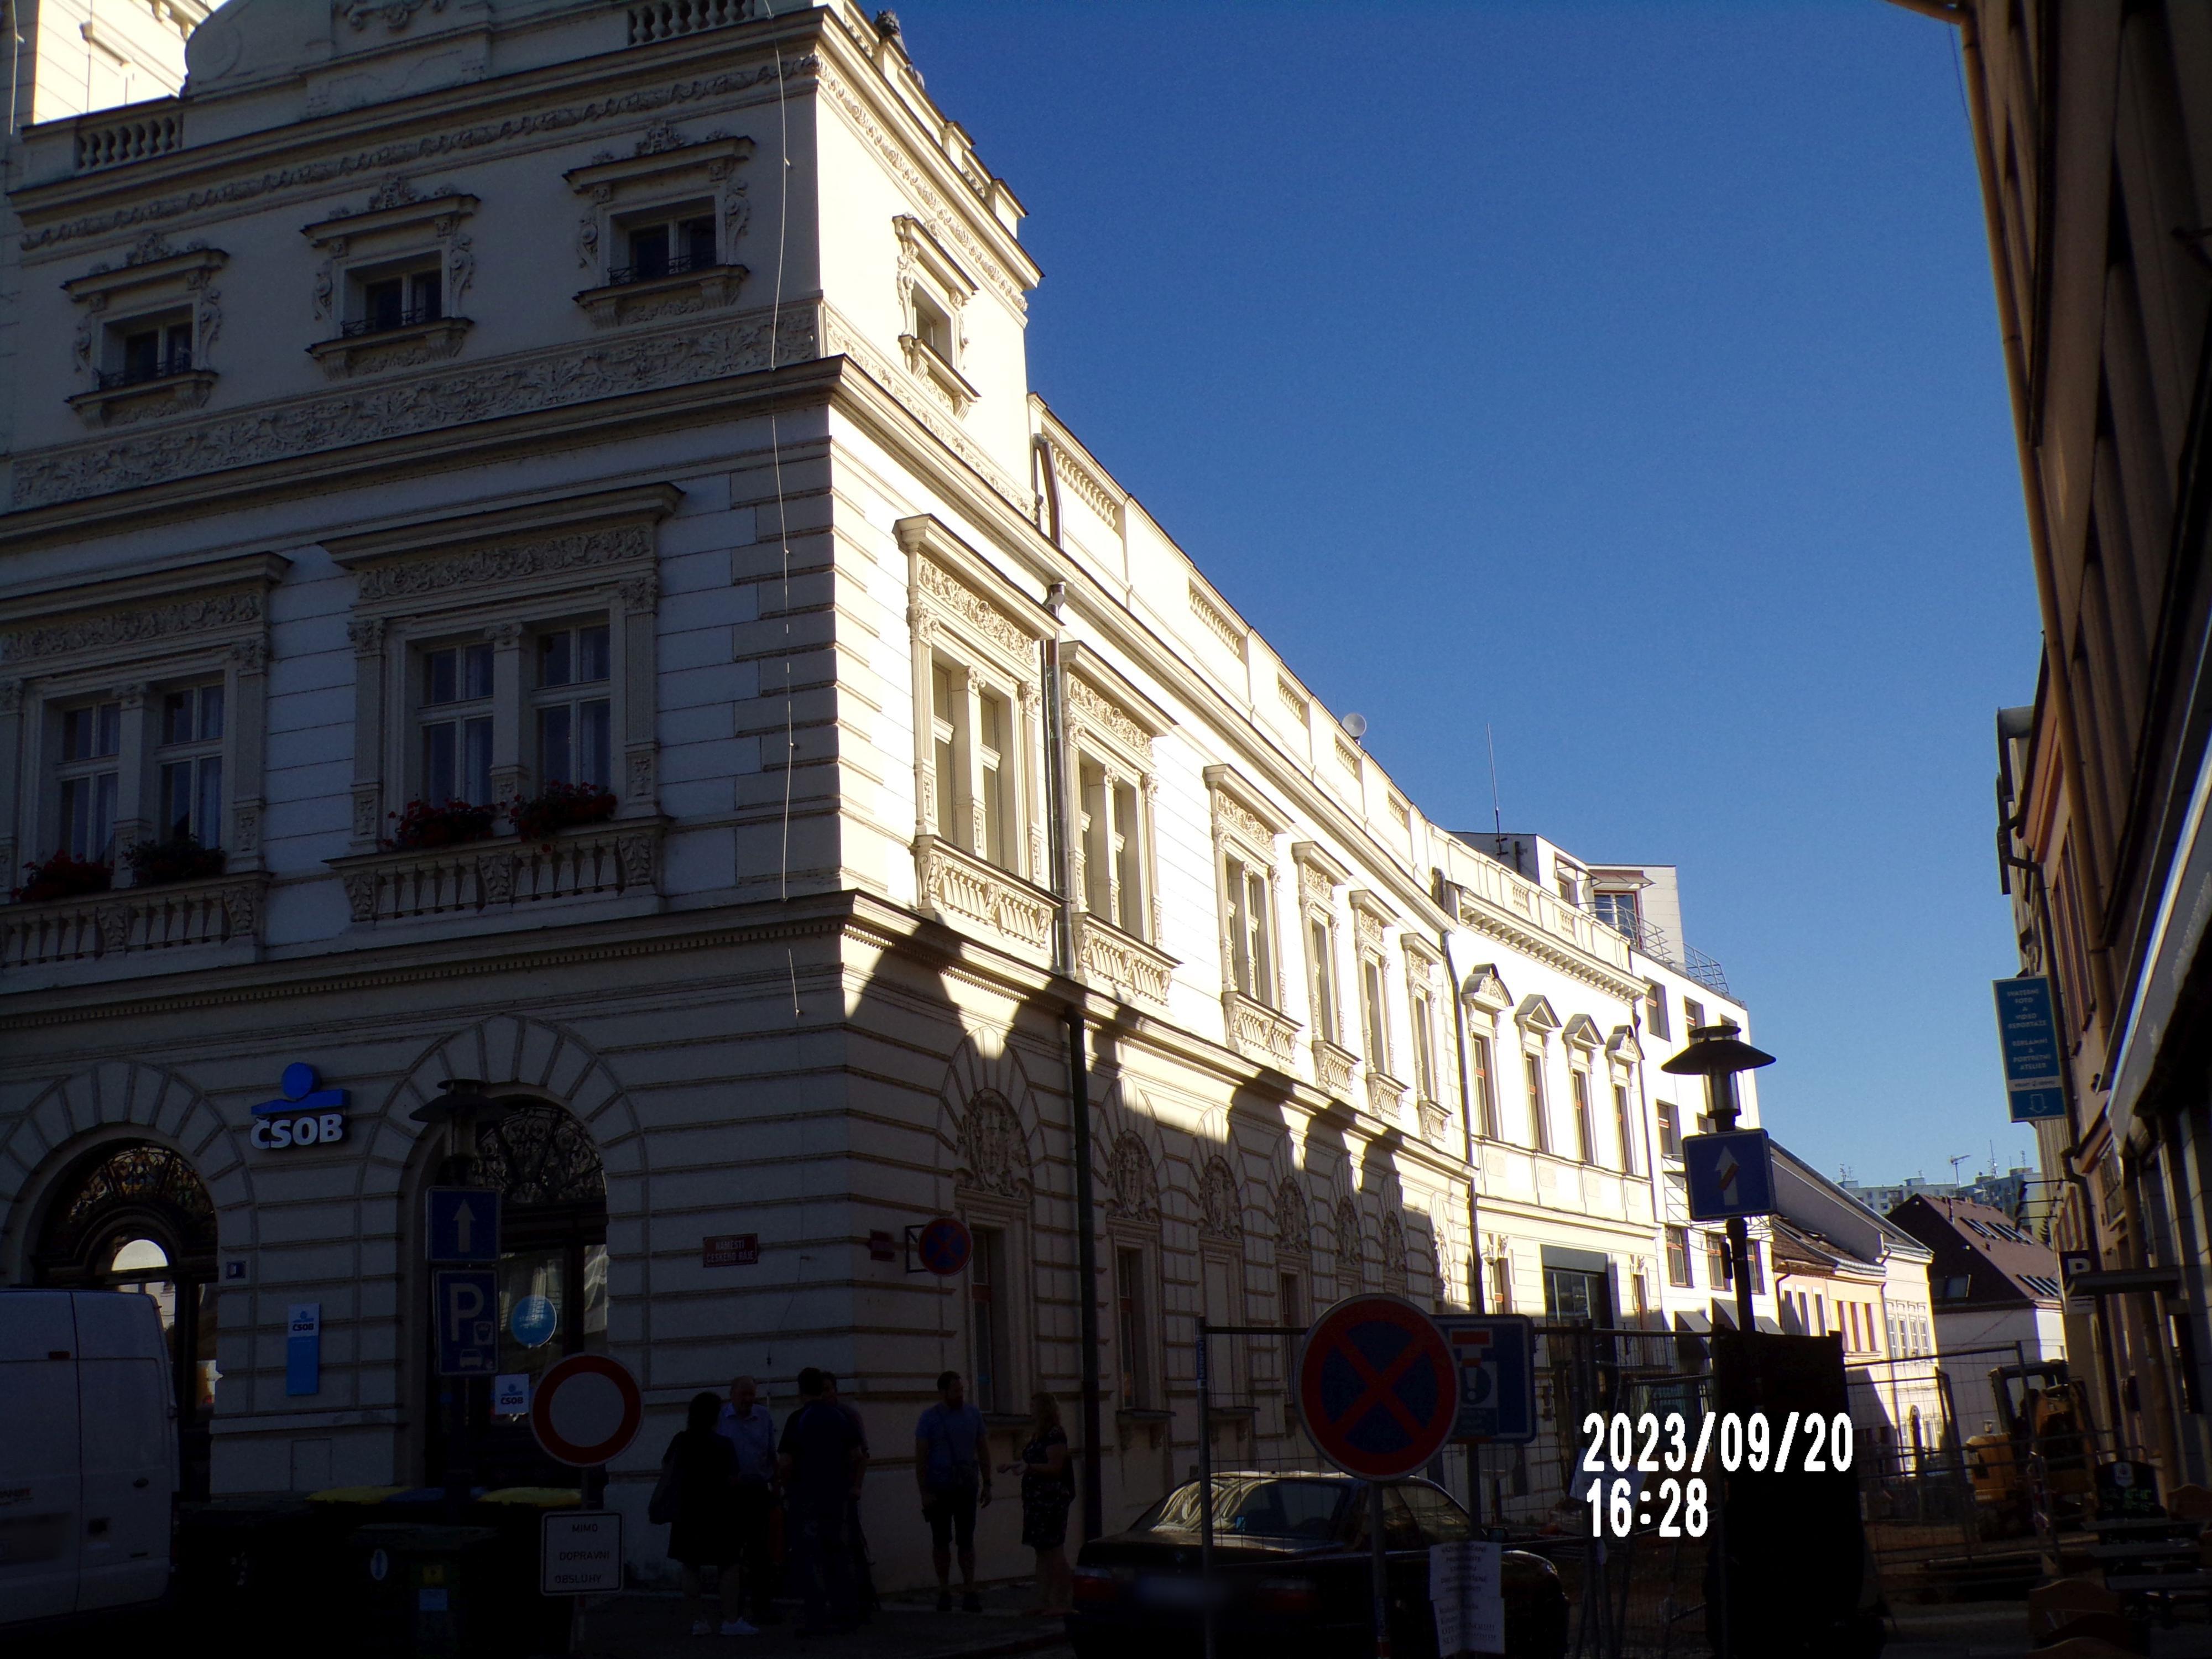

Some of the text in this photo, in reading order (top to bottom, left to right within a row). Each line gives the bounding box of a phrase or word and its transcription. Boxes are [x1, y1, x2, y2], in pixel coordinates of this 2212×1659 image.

[251, 1114, 343, 1150] ČSOB
[450, 1282, 484, 1342] P
[572, 1524, 598, 1532] MIMO
[555, 1574, 602, 1583] OBSLUHY
